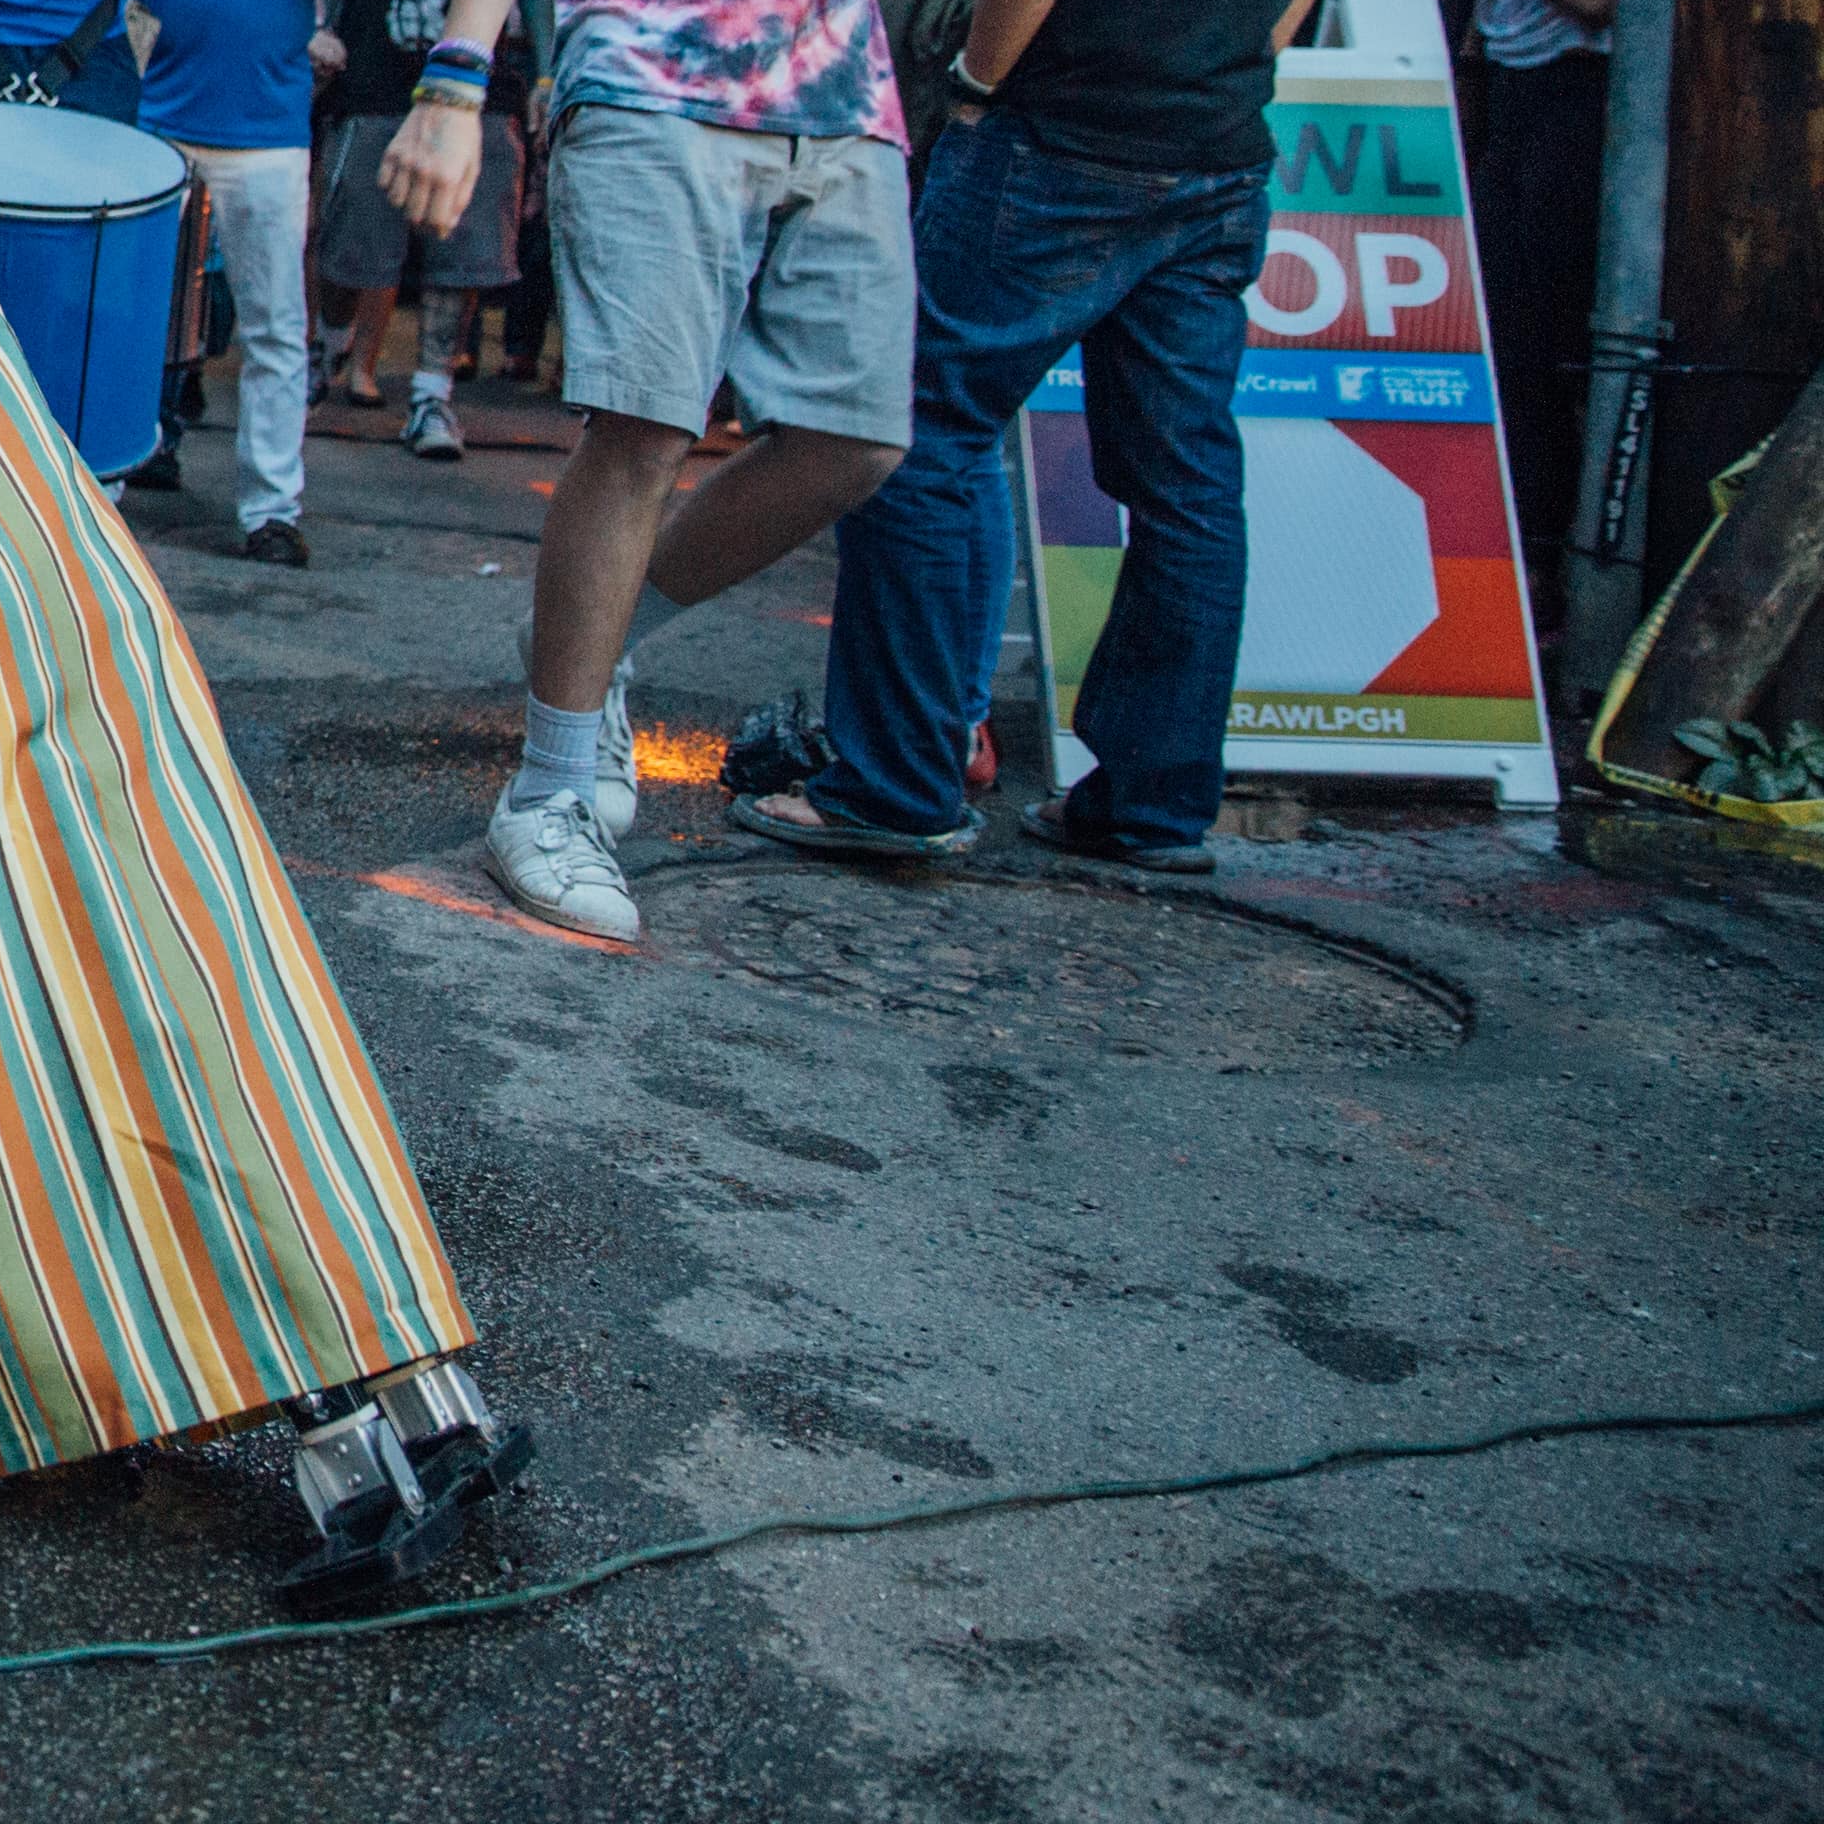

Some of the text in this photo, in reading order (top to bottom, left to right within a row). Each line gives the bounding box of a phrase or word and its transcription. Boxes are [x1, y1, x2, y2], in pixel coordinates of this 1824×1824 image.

[1272, 122, 1444, 197] WL
[1240, 228, 1450, 337] OP
[1388, 390, 1465, 407] TRUST
[1227, 702, 1407, 735] RAWLPGH
